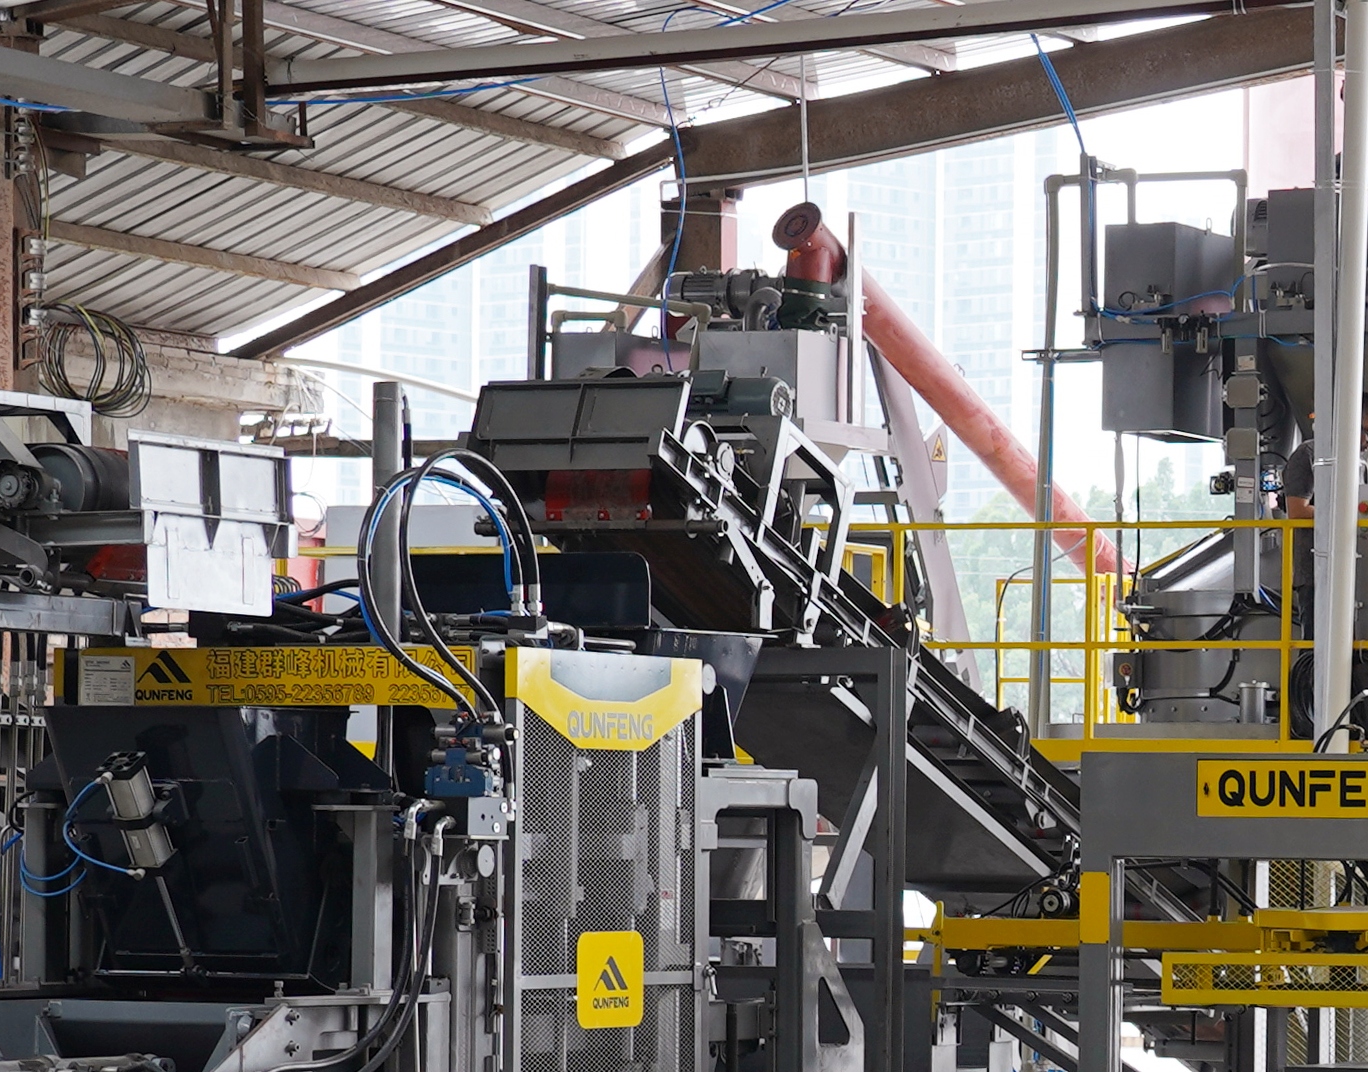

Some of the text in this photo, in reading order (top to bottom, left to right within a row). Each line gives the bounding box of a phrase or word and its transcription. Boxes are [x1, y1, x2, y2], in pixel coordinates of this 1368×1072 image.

[136, 689, 193, 701] QUNFENG
[206, 684, 375, 704] TEL:0595-22356789
[567, 710, 654, 740] QUNFENG
[592, 996, 630, 1010] QUNFENG
